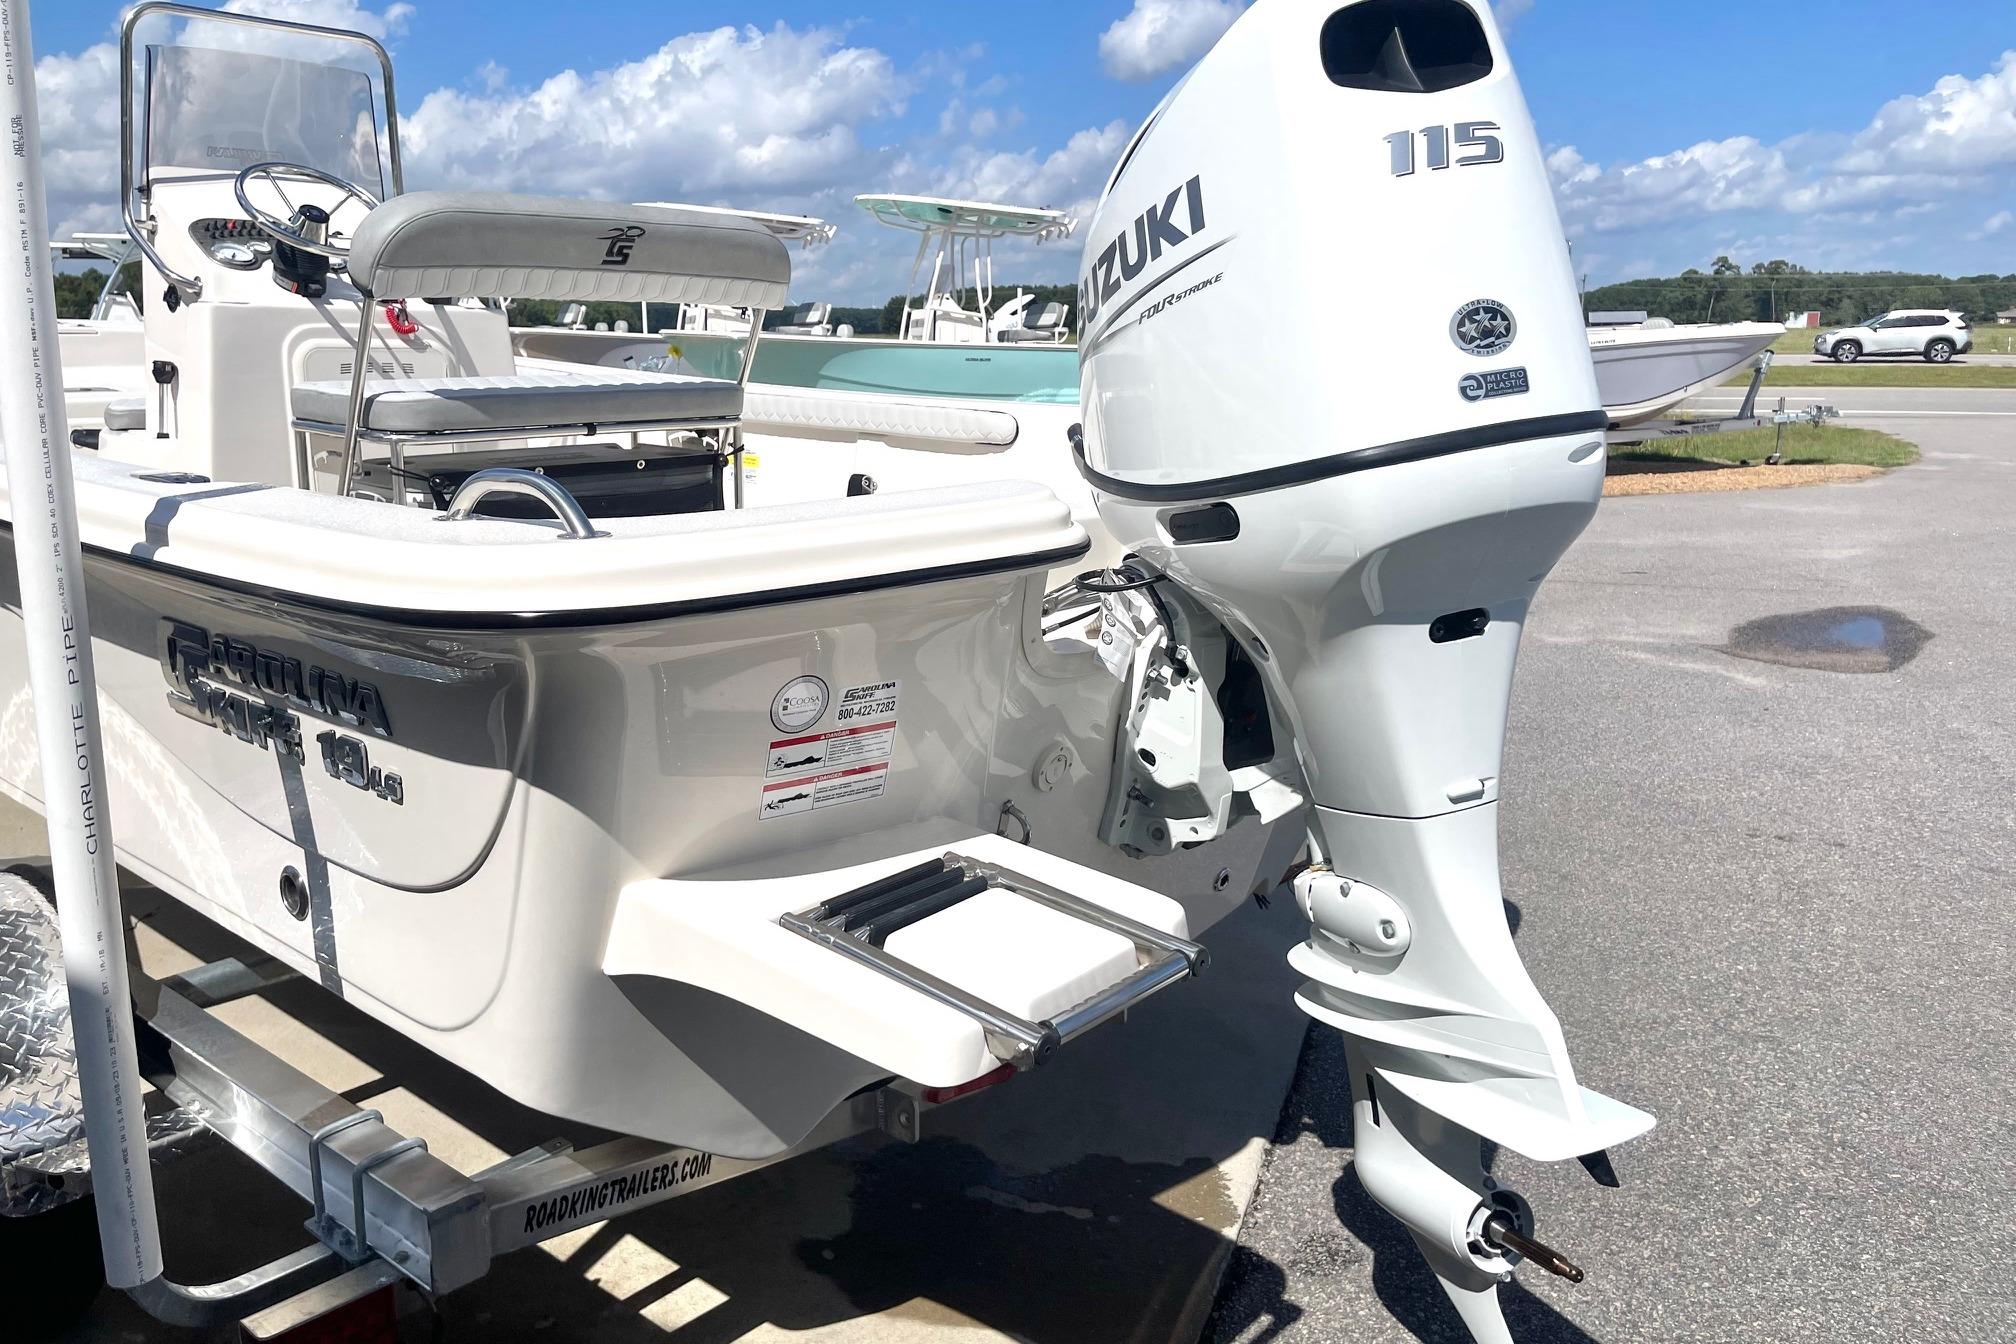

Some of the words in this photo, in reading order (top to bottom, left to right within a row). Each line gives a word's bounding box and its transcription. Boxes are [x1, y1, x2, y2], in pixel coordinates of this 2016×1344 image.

[11, 117, 19, 135] FOR
[1382, 120, 1505, 178] 115
[17, 181, 26, 214] 891-16
[21, 229, 29, 252] ASTM
[1078, 174, 1206, 343] SUZUKI
[1487, 370, 1524, 382] MICRO
[1487, 379, 1527, 391] PLASTIC
[39, 412, 47, 434] CORE
[42, 438, 51, 479] CELLULAR
[47, 484, 55, 504] COEX
[50, 508, 57, 519] 40
[62, 615, 80, 686] PIPE
[160, 616, 394, 737] CAROLINA
[790, 695, 820, 707] COOSA
[844, 681, 896, 699] CAROLINA
[838, 700, 896, 720] 800-422-7282
[825, 730, 850, 739] DANGER
[316, 729, 370, 791] 19
[72, 702, 98, 855] CHARLOTTE
[819, 772, 843, 781] DANGER
[524, 1153, 712, 1233] ROADKINGTRAILERS.COM
